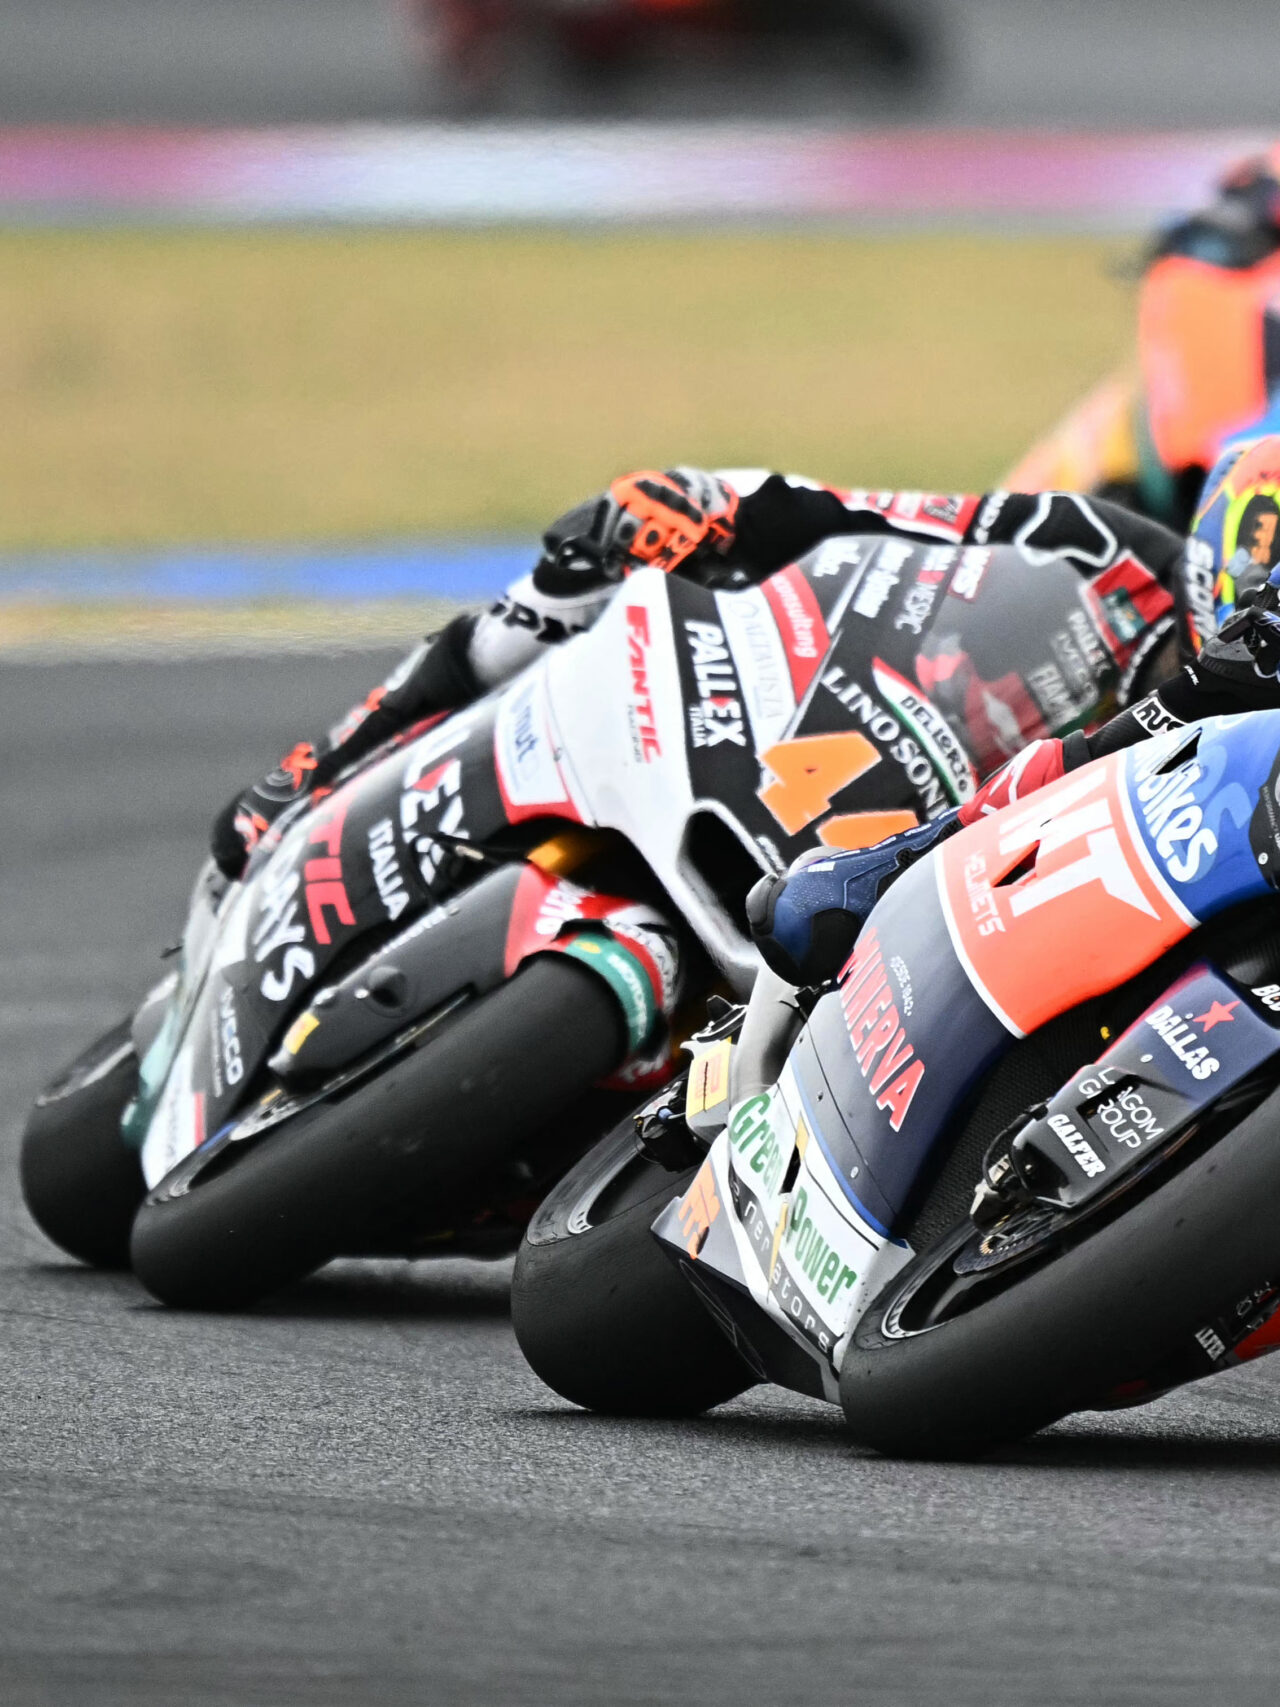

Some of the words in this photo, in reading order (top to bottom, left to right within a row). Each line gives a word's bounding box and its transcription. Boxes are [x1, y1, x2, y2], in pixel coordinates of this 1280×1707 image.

[625, 605, 663, 763] FANTIC
[684, 620, 747, 747] PALLEX
[820, 666, 900, 743] LINO
[368, 817, 410, 921] ITALIA
[838, 926, 926, 1133] MINERVA
[1145, 1005, 1220, 1080] DALLAS
[1046, 1114, 1107, 1178] GALFER
[789, 1184, 858, 1305] Power
